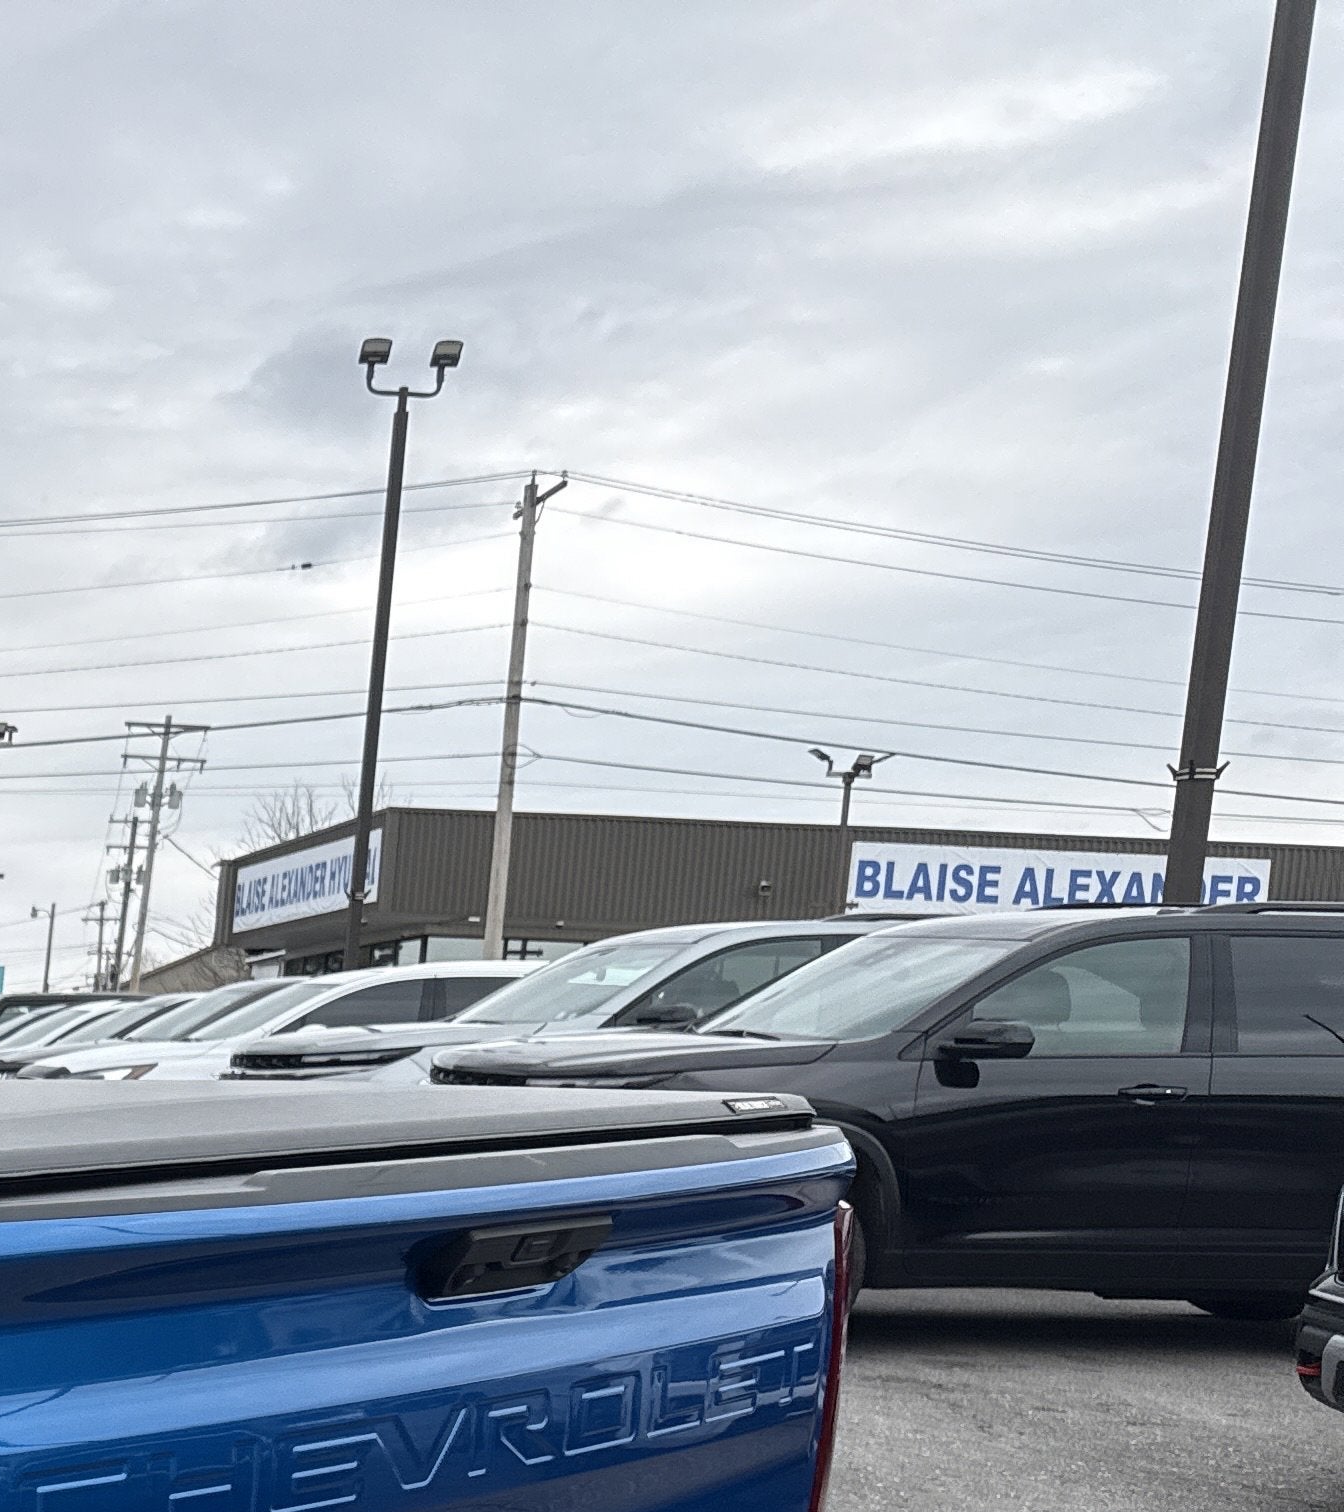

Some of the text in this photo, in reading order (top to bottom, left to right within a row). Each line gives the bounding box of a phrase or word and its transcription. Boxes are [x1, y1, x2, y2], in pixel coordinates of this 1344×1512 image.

[235, 847, 378, 917] BLAISE ALEXANDER HYUAI
[855, 860, 1261, 906] BLAISE ALEXAER
